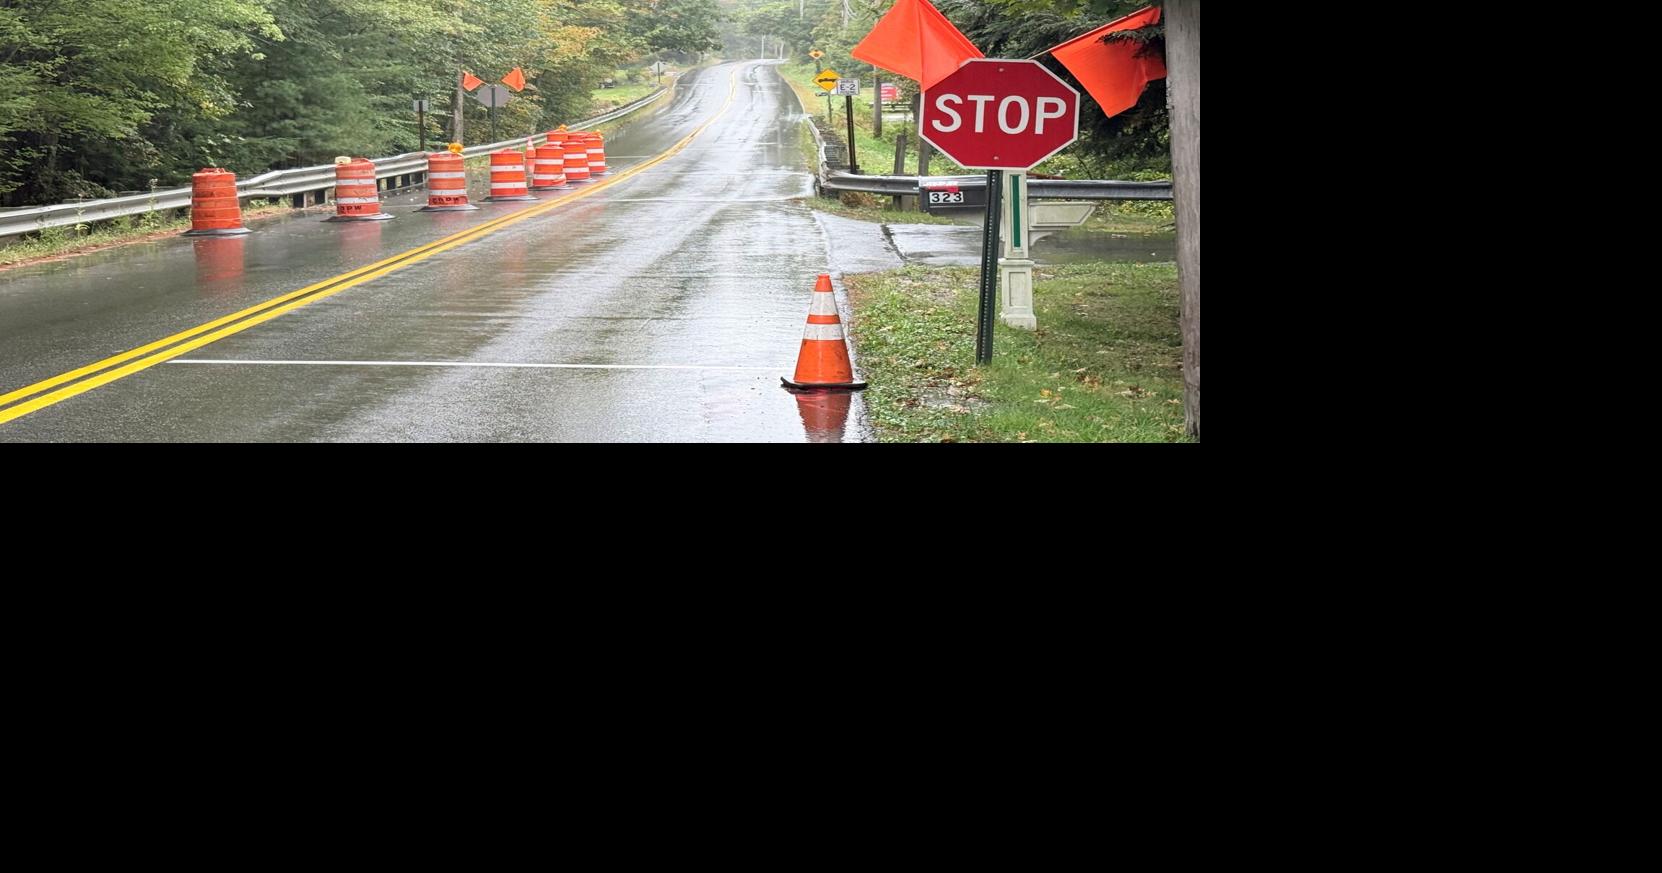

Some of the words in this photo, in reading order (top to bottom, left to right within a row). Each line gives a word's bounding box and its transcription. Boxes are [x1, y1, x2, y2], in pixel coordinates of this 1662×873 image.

[840, 83, 856, 91] E-2
[931, 93, 1067, 135] STOP
[931, 192, 962, 203] 323
